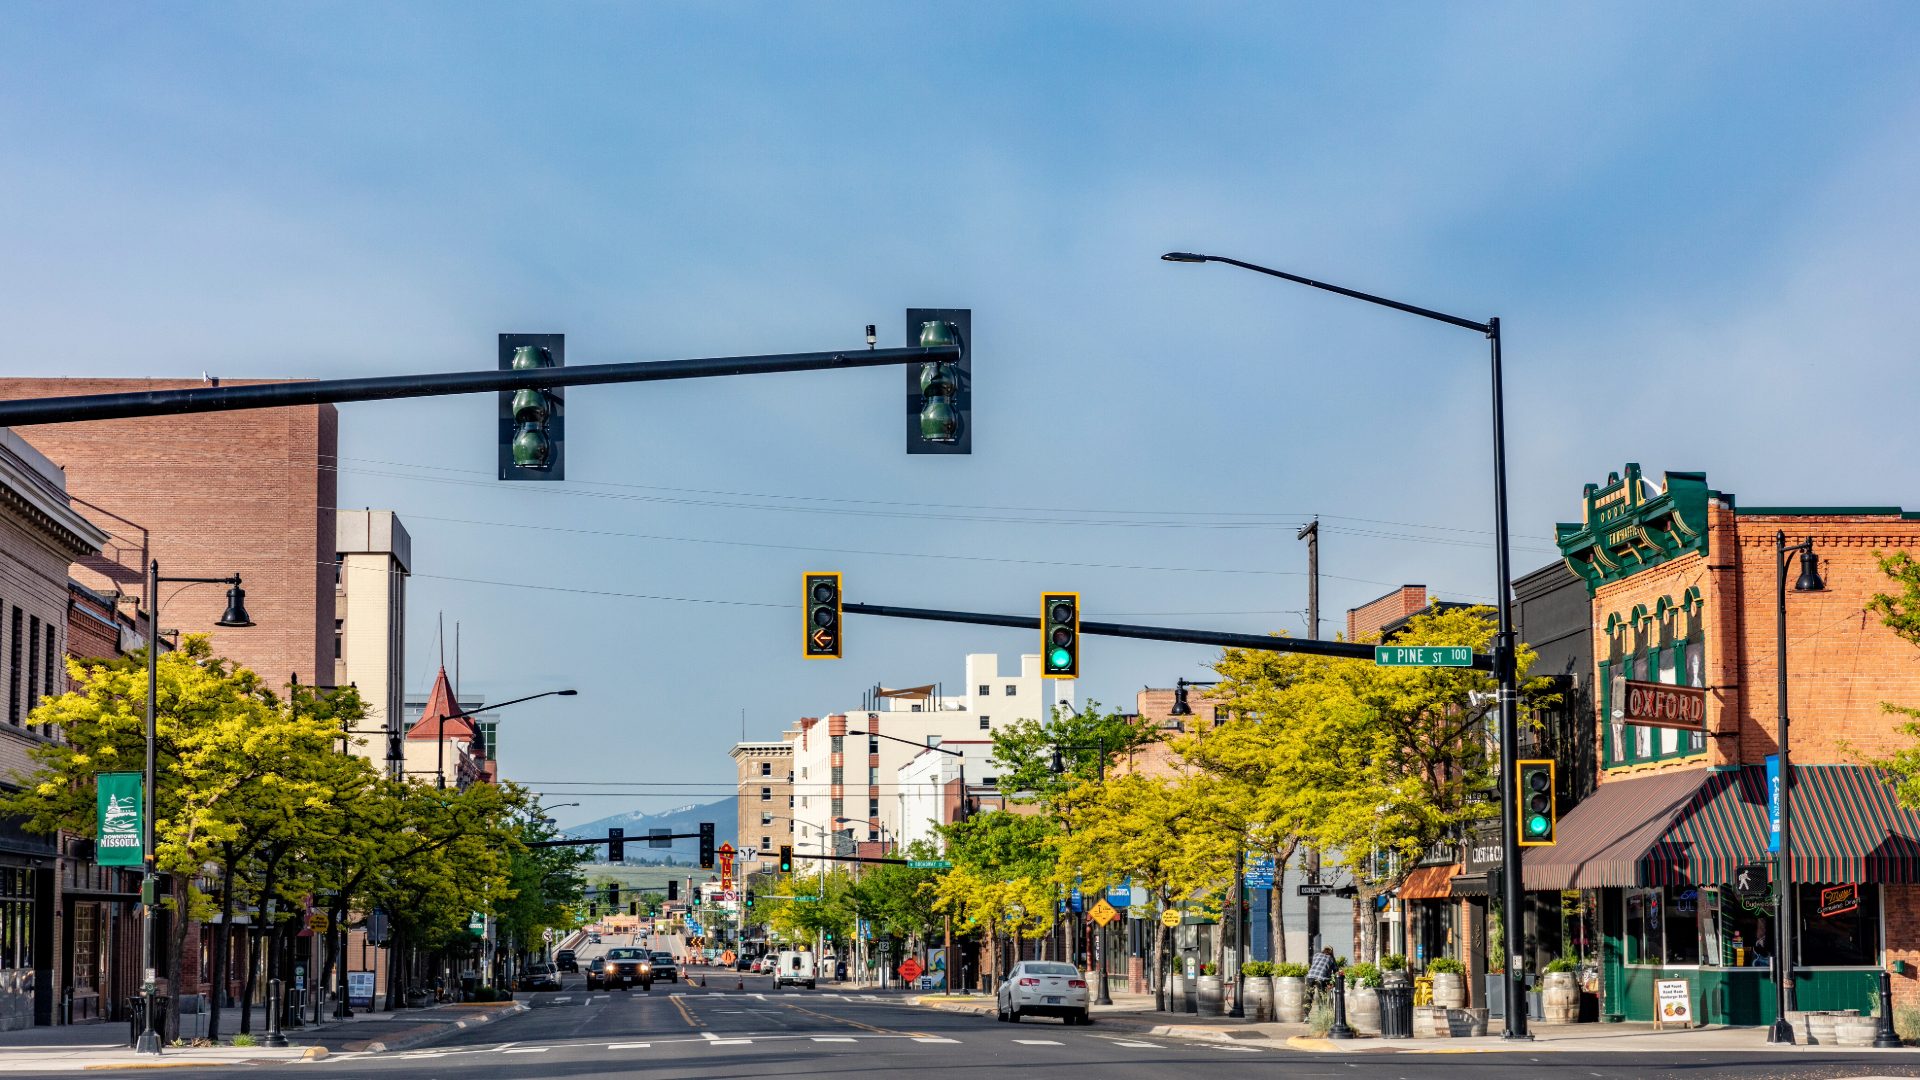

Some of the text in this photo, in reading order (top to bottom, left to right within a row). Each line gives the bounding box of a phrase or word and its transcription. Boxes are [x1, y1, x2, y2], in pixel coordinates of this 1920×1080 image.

[1381, 648, 1467, 663] W PINE ST 100
[1629, 688, 1704, 721] OXFORD
[100, 839, 140, 848] MISSOULA
[1825, 889, 1853, 905] Miller
[880, 942, 888, 950] 12
